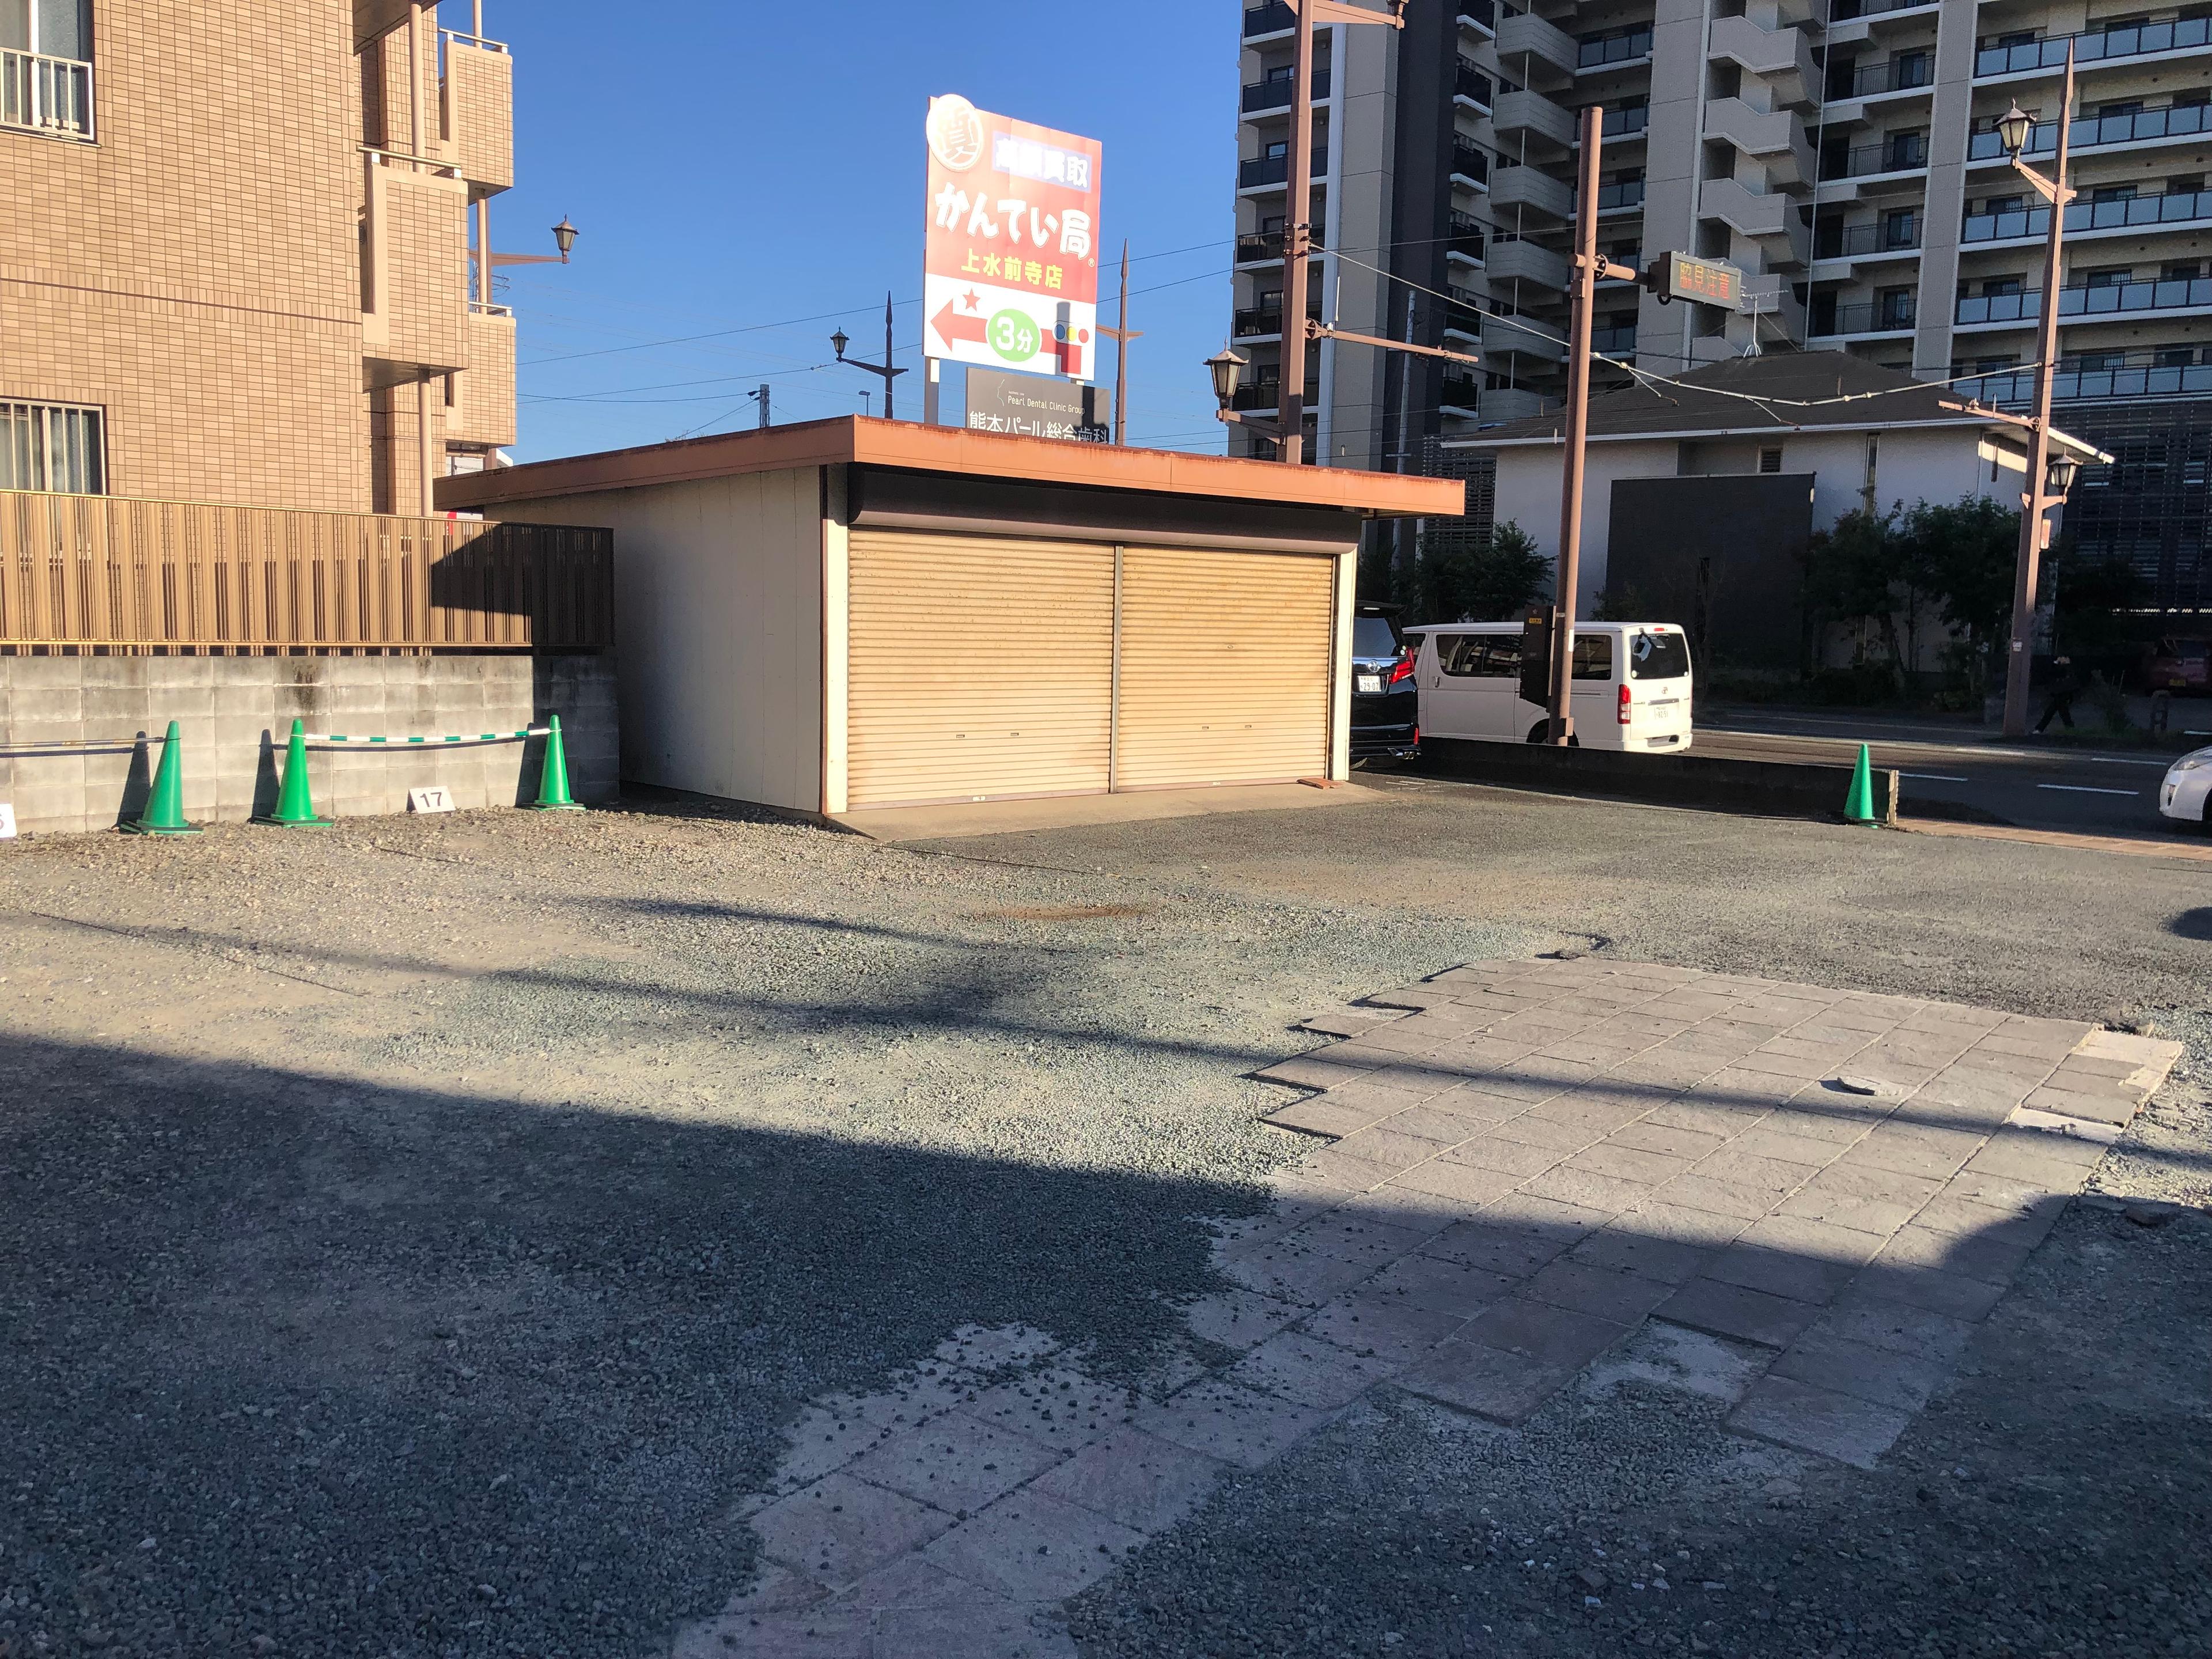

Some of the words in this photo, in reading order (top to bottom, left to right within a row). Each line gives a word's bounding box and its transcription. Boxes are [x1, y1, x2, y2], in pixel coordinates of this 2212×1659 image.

[934, 181, 1092, 260] かんてい局
[961, 248, 1063, 289] 上水前寺店
[995, 316, 1033, 354] 3分
[1008, 395, 1025, 407] Pearl
[1027, 399, 1047, 410] Dental
[1050, 402, 1066, 412] Clinic
[1068, 404, 1085, 416] Group
[419, 791, 442, 808] 17
